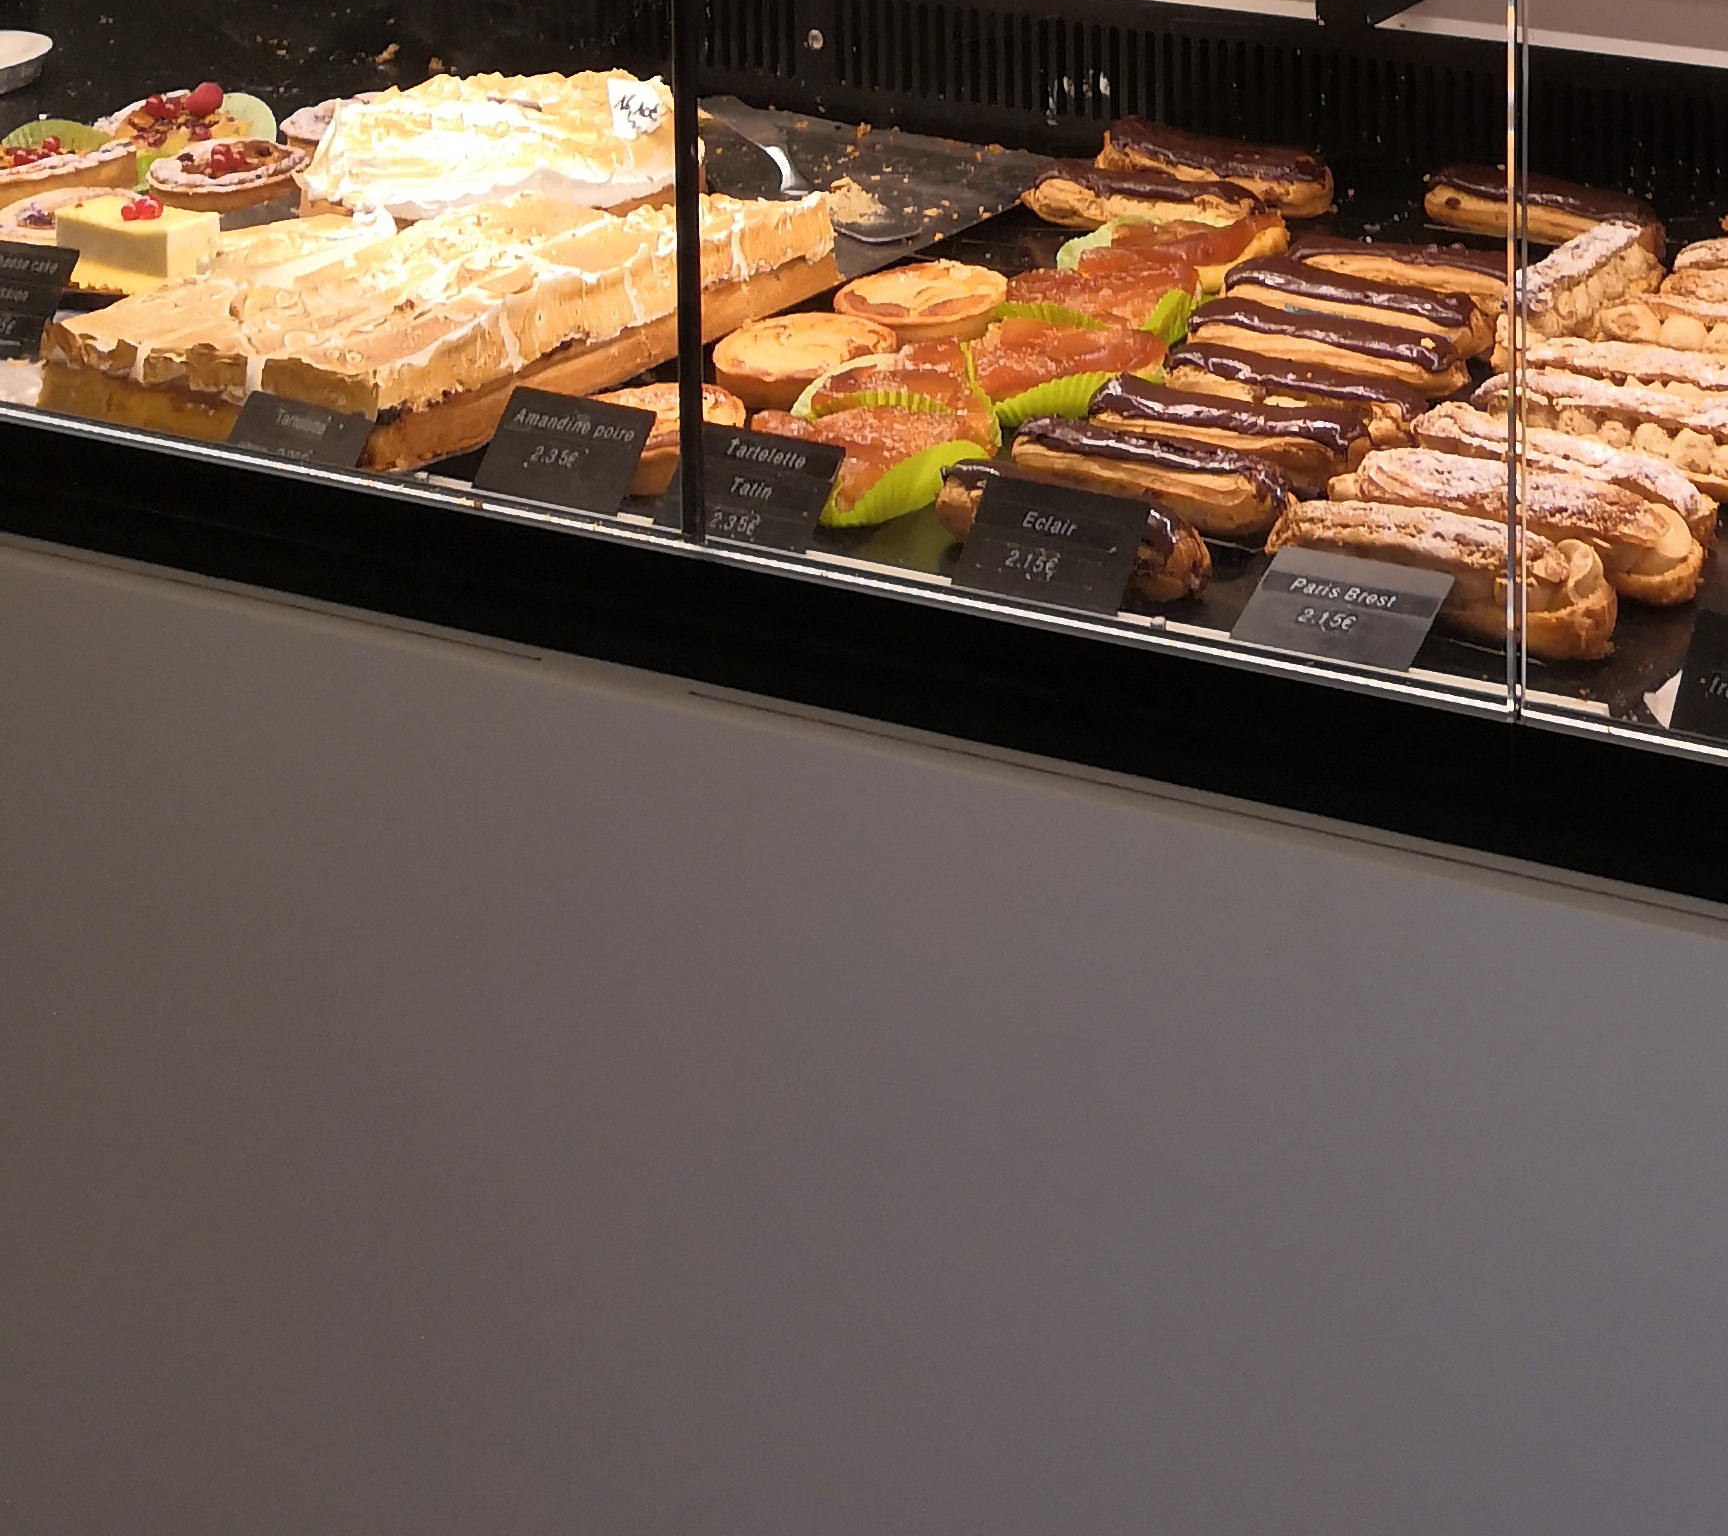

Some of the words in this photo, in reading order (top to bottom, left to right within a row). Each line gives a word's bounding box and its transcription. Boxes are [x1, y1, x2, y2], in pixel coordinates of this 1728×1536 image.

[513, 407, 592, 436] Amandine
[593, 425, 635, 443] poire
[726, 436, 806, 469] Tartelette
[730, 476, 773, 500] Tatin
[1022, 509, 1077, 537] Eclair
[1290, 577, 1341, 600] Paris
[1344, 586, 1397, 608] Brest
